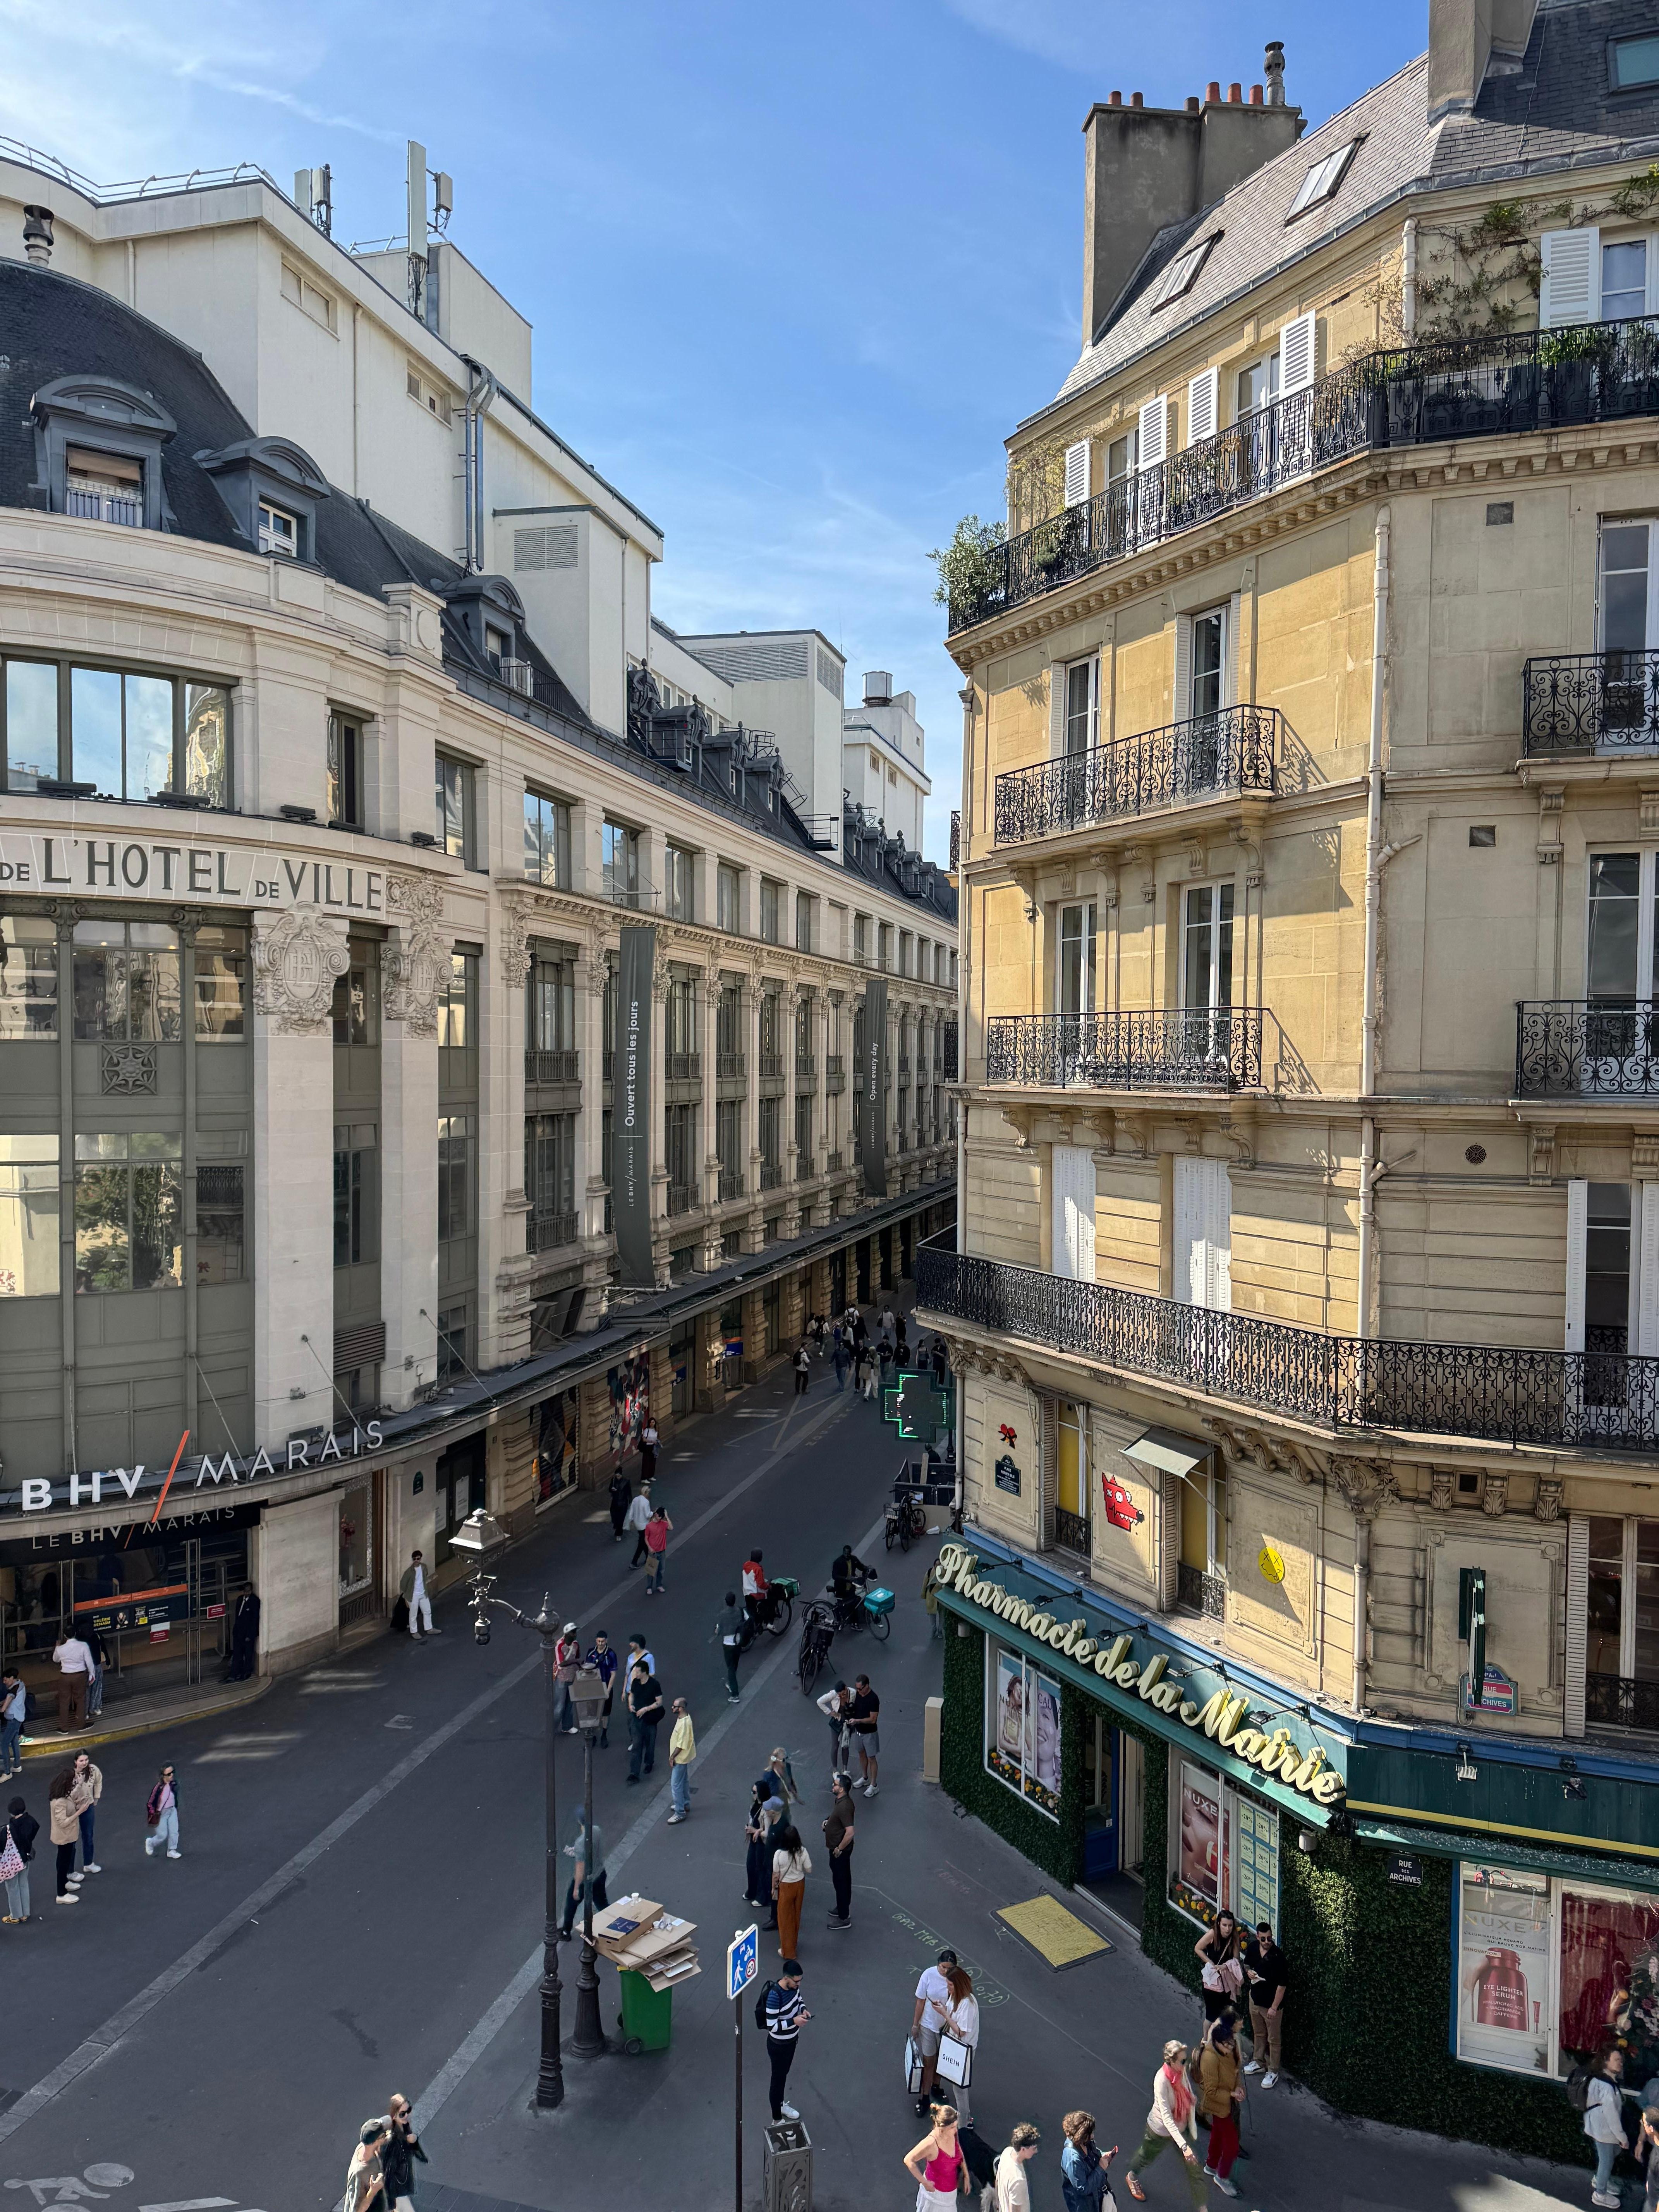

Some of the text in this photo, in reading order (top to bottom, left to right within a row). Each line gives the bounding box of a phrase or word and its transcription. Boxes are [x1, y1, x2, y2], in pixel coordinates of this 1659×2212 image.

[0, 838, 381, 912] DE L'HOTEL DE VILLE
[625, 1001, 640, 1127] Ouvert tous les jours
[629, 1198, 634, 1207] LE
[196, 1420, 383, 1488] MARAIS
[33, 1534, 60, 1549] LE
[71, 1525, 121, 1545] BHV
[143, 1506, 235, 1534] MARAIS
[935, 1543, 1346, 1803] Pharmacie de la Mairie
[1481, 1699, 1506, 1707] CHIVES
[1184, 1788, 1218, 1817] NUXE
[1399, 1860, 1412, 1869] RUE
[1389, 1872, 1421, 1884] ARCHIVES
[892, 1913, 915, 1930] GAZ
[1464, 1914, 1526, 1933] NUXE
[1463, 1946, 1497, 1956] INNOVATION
[747, 1963, 753, 1973] 20
[1491, 1991, 1515, 2000] SERUM
[1496, 1985, 1523, 1997] LIGHTER
[942, 2054, 960, 2067] SHEIN
